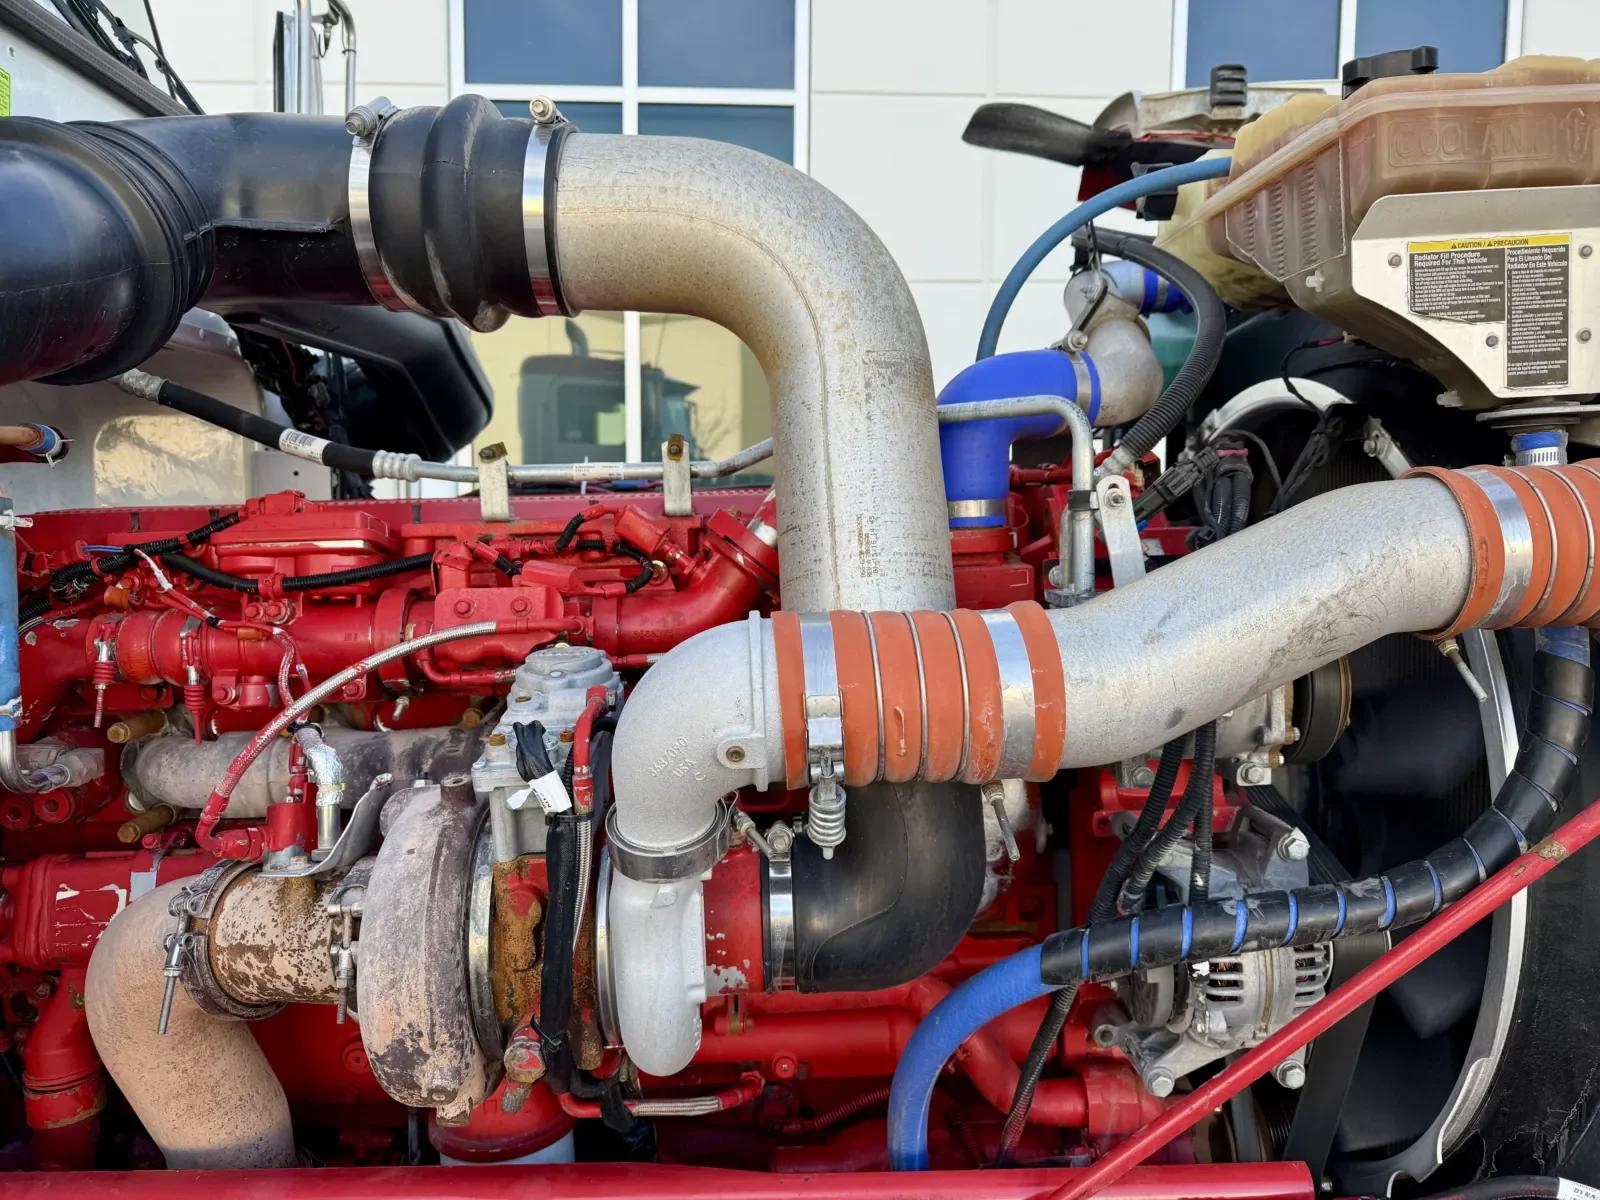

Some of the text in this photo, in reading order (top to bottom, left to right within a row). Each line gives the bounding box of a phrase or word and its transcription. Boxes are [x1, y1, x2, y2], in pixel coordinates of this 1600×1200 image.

[1457, 241, 1482, 249] CAUTION
[1414, 251, 1481, 261] Radiator Fill Procedure
[1414, 256, 1488, 267] Required For This Vehicle
[1507, 262, 1529, 270] Radiador
[1536, 260, 1547, 268] Este
